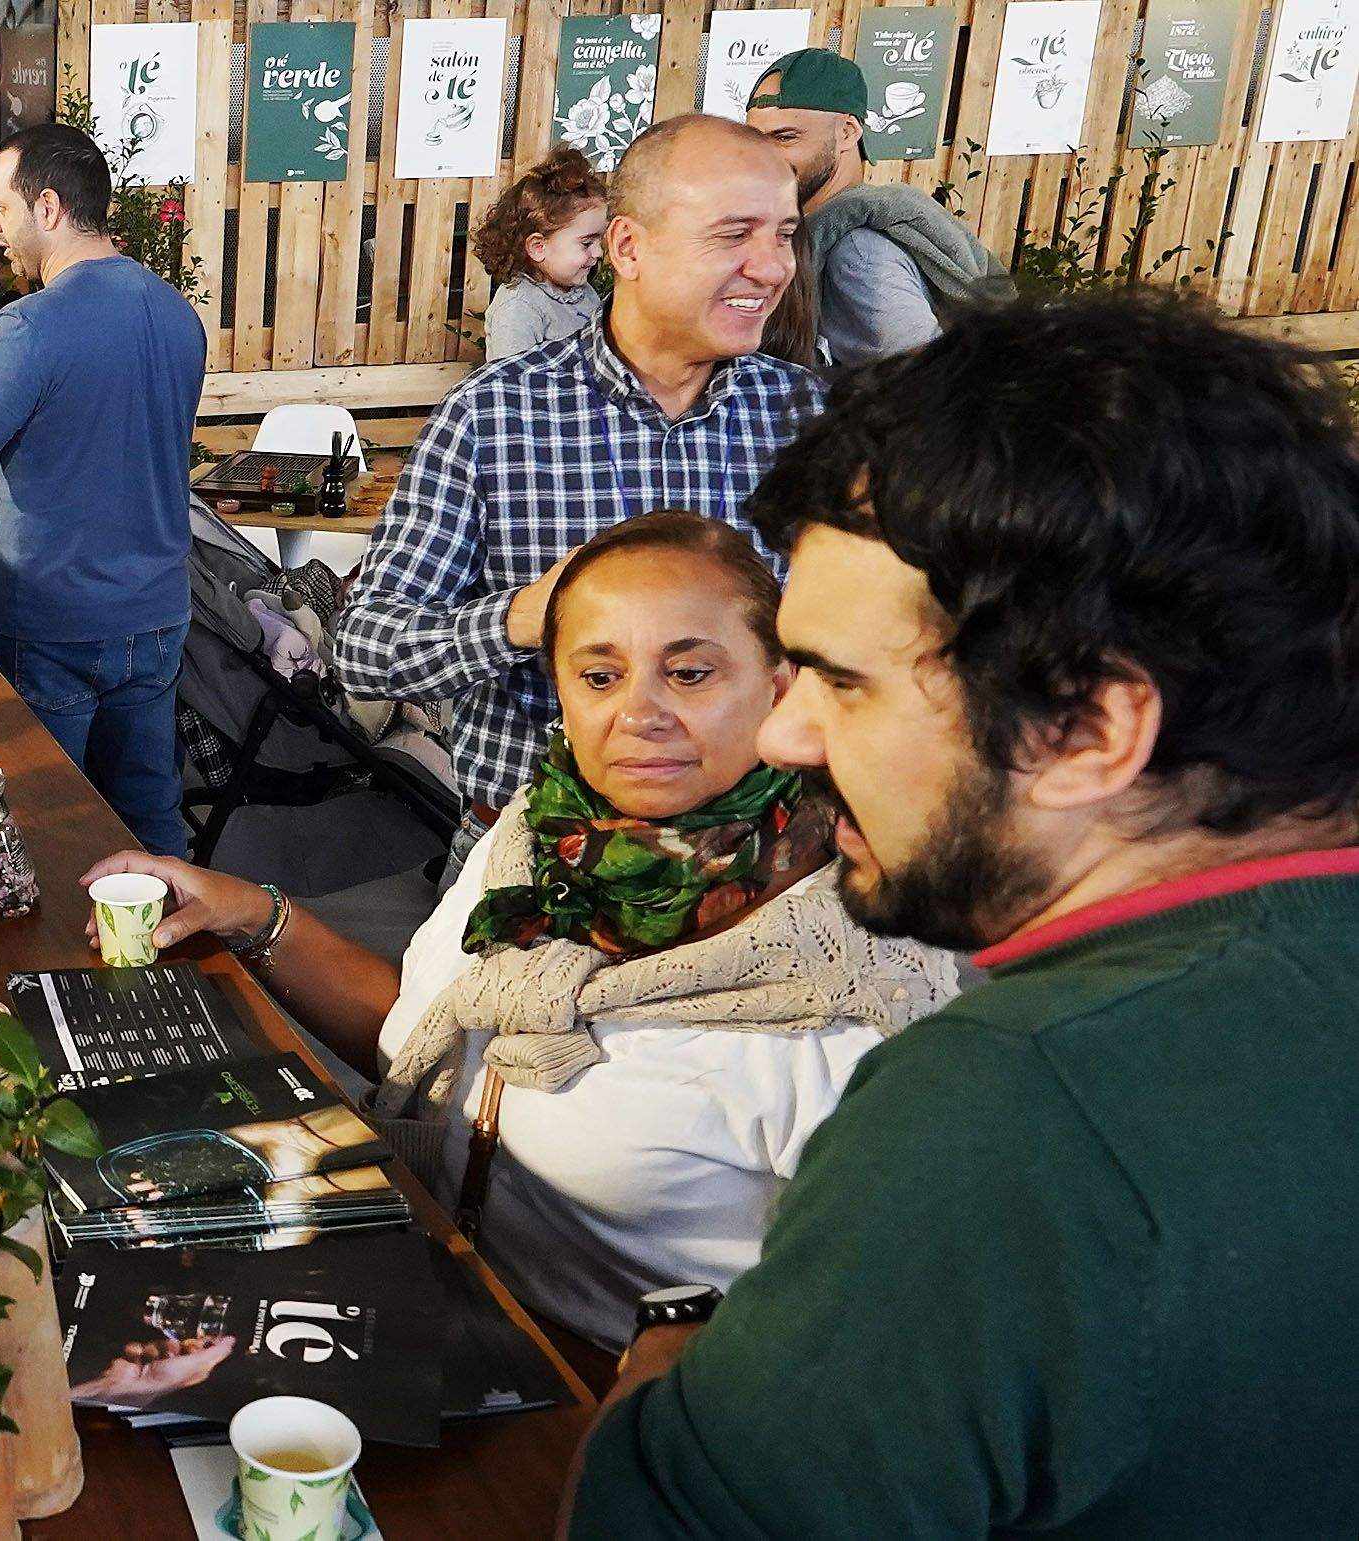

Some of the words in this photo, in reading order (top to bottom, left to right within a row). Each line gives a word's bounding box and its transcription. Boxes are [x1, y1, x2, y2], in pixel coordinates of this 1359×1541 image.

[430, 51, 479, 68] salón
[573, 40, 647, 64] camelia,
[728, 39, 746, 60] O
[751, 38, 770, 57] té
[893, 31, 935, 64] té
[1037, 29, 1066, 65] té
[1309, 41, 1340, 80] té
[128, 52, 161, 95] té
[262, 61, 341, 89] verde
[428, 70, 444, 82] de
[436, 70, 477, 101] té
[266, 1299, 362, 1364] té
